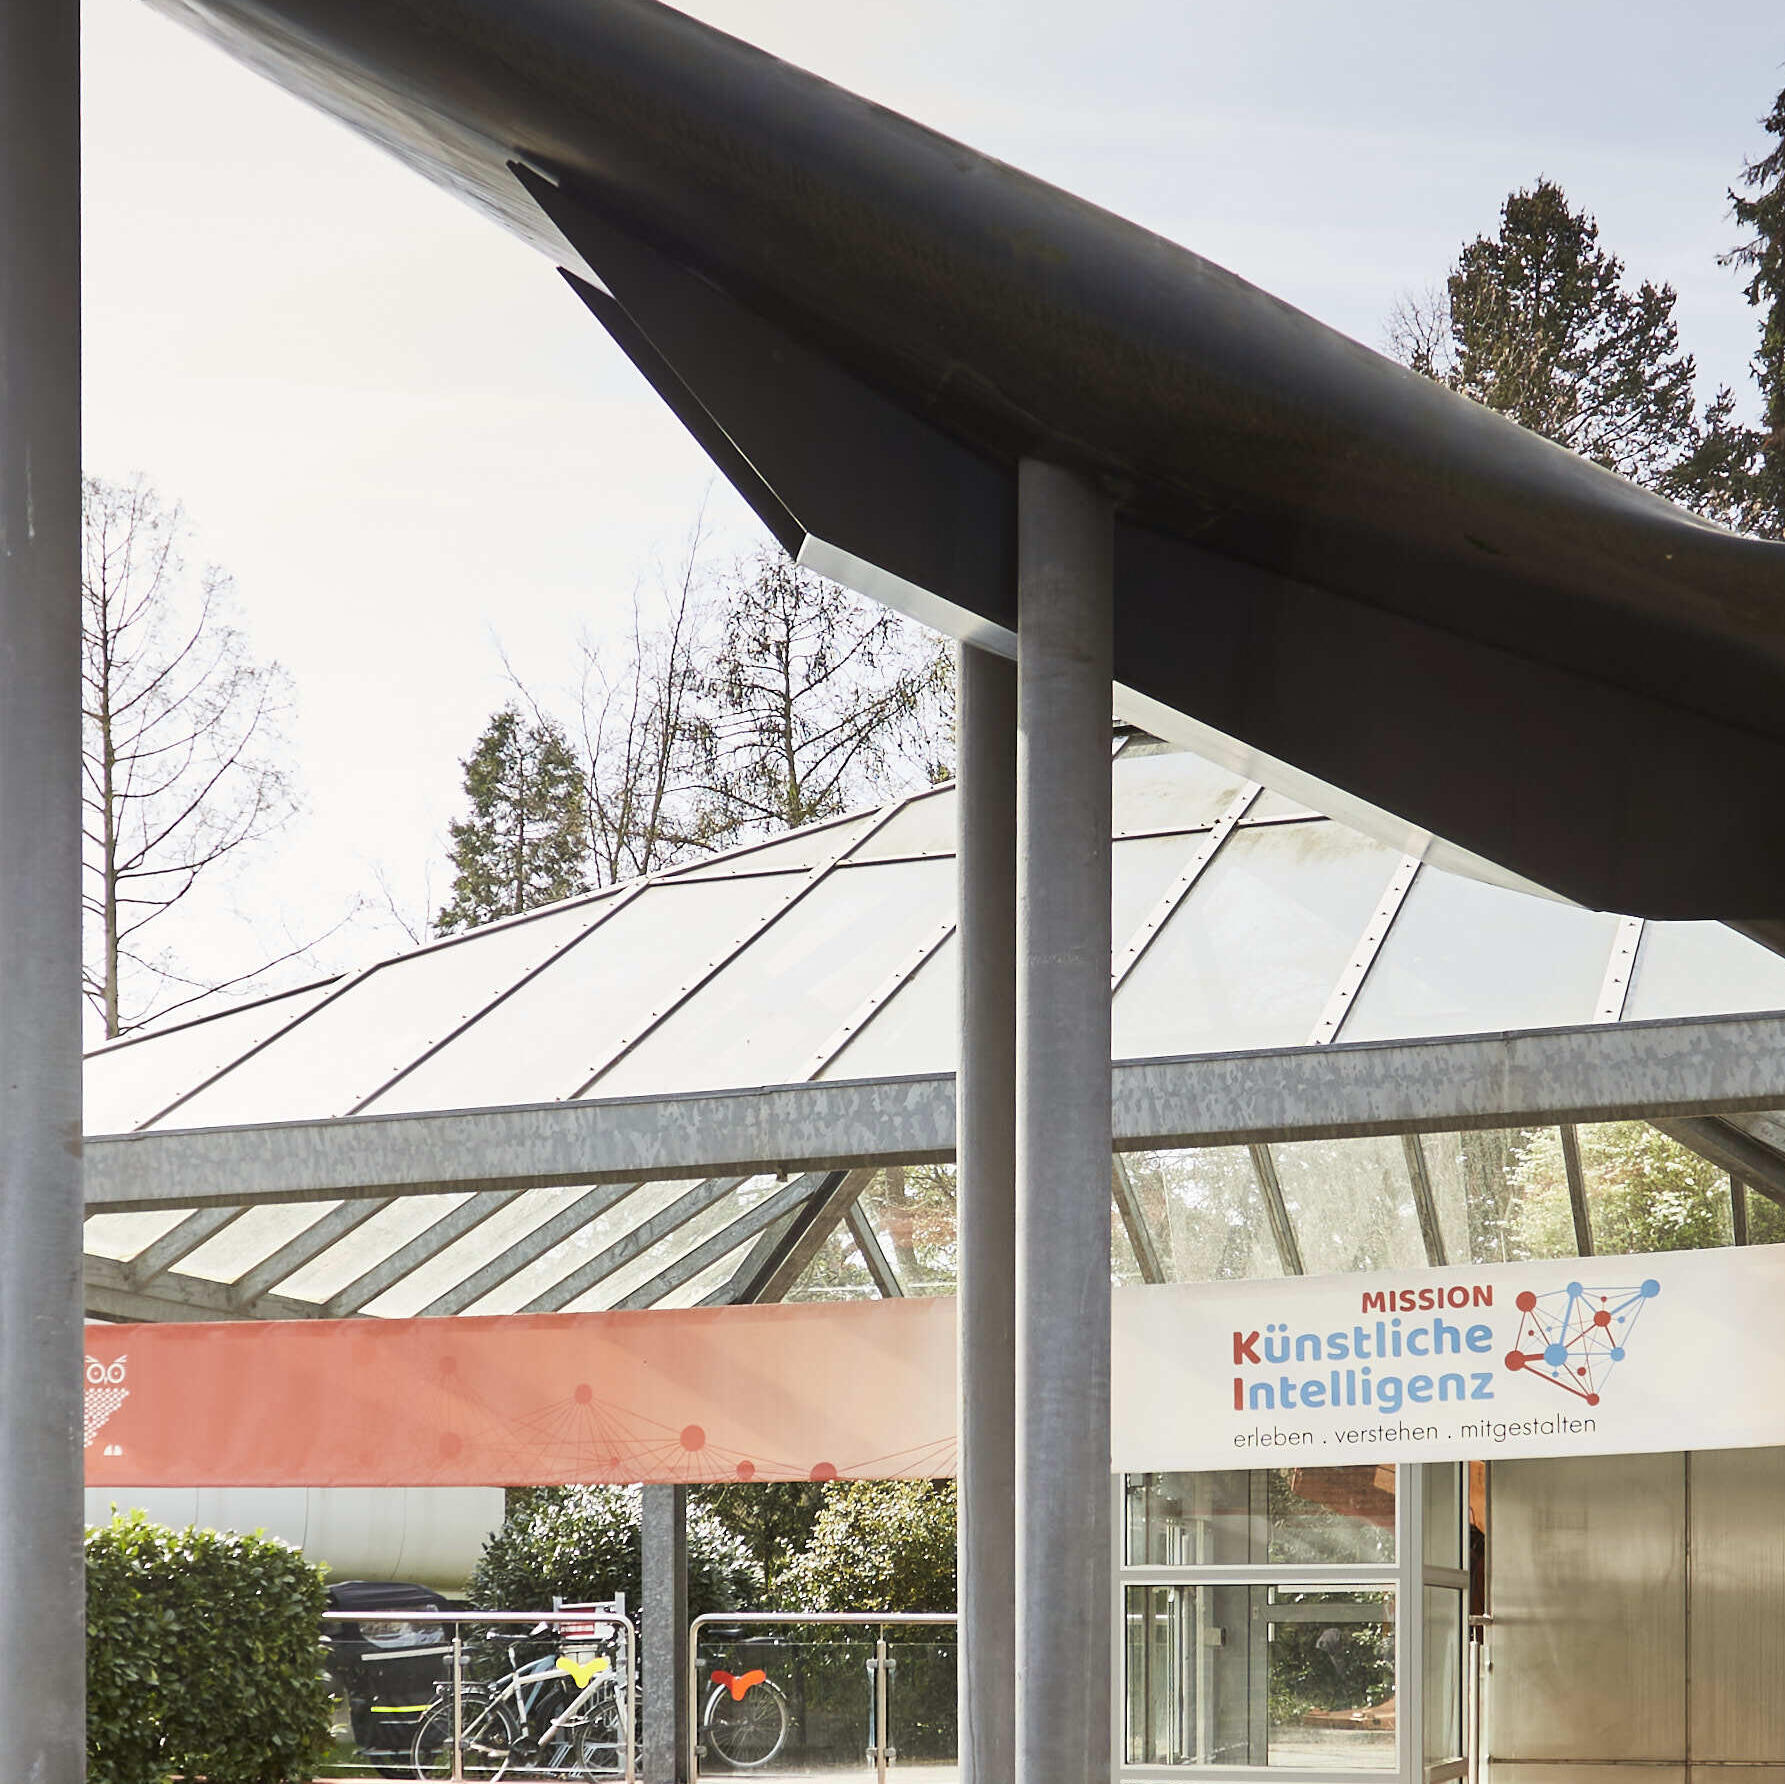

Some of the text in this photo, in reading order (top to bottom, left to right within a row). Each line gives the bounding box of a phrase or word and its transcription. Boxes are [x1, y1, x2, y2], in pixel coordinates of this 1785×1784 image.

[1361, 1284, 1494, 1314] MISSION
[1232, 1317, 1493, 1366] Künstliche
[1232, 1366, 1495, 1415] Intelligenz
[1233, 1425, 1314, 1449] erleben
[1334, 1420, 1439, 1445] verstehen
[1460, 1412, 1597, 1444] mitgestalten
